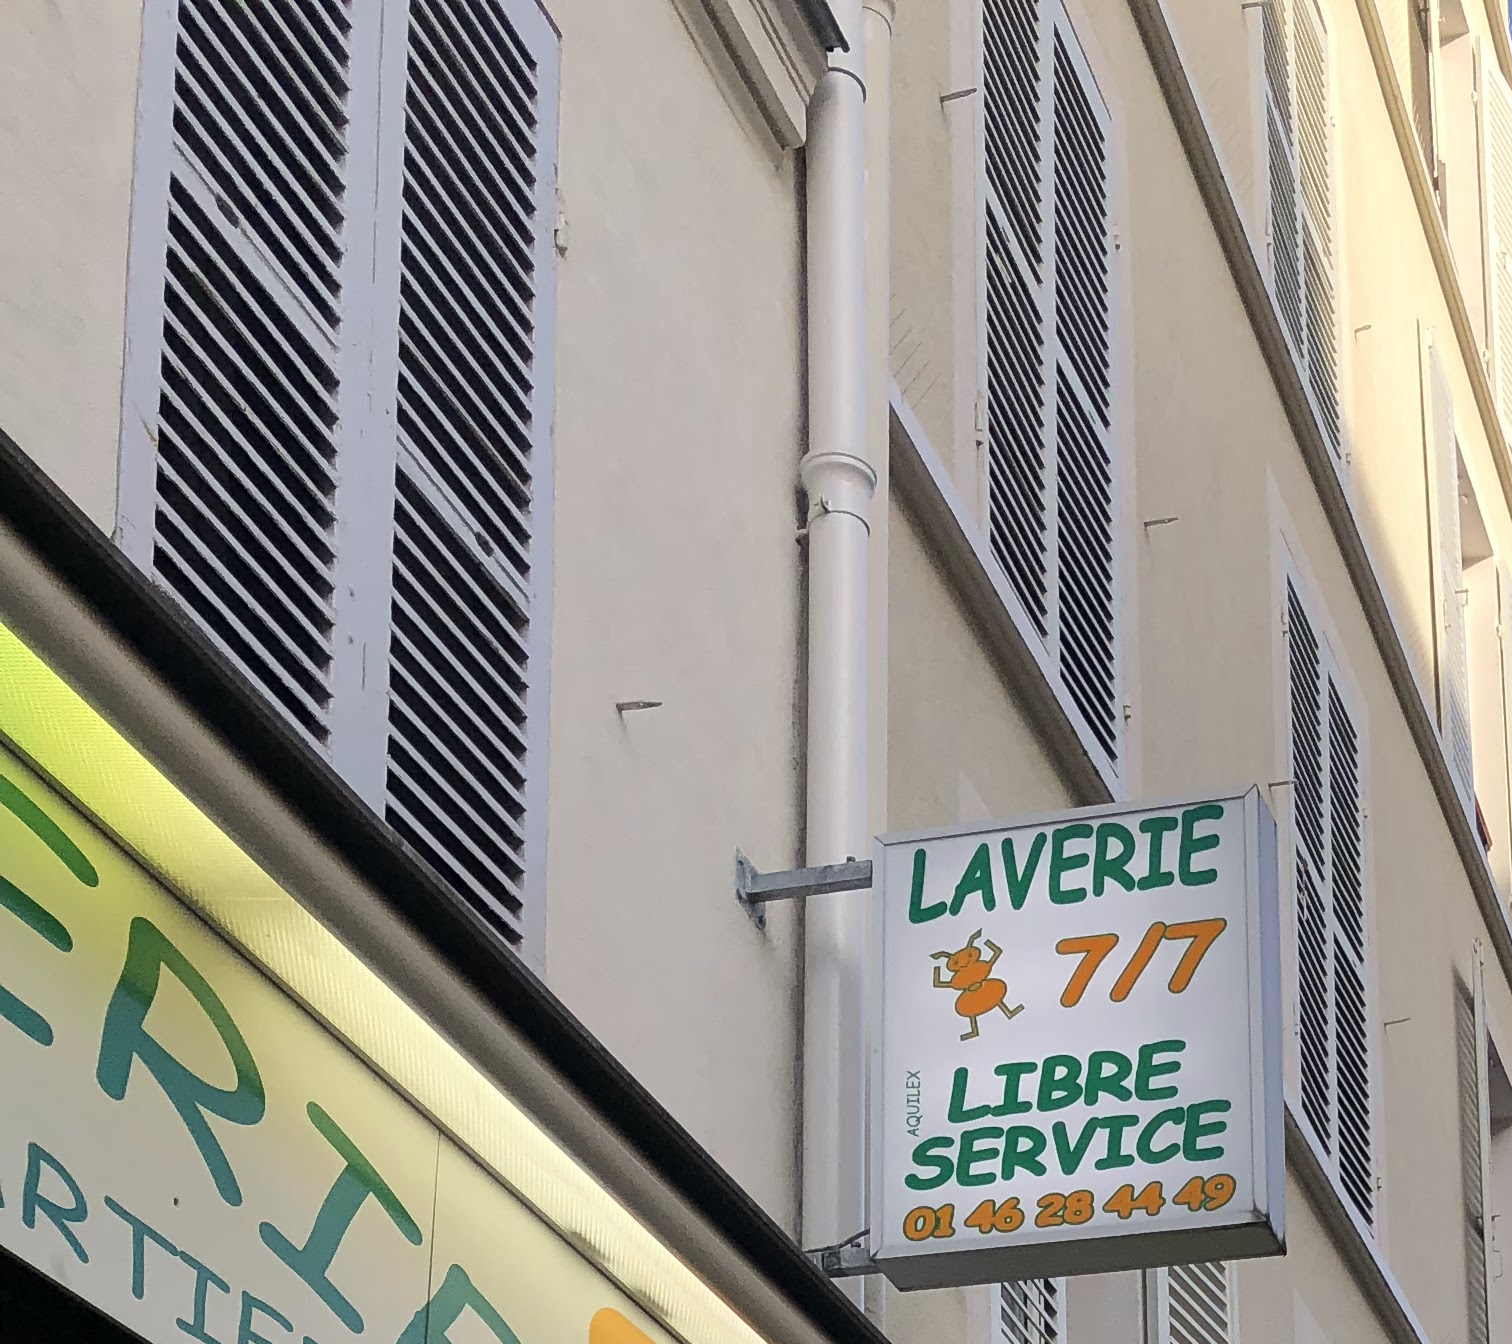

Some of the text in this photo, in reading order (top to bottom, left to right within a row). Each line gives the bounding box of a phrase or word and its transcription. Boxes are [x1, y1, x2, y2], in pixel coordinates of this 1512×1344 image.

[908, 804, 1224, 924] LAVERIE
[1055, 917, 1228, 1008] 7/7
[906, 1070, 922, 1138] AQUILEX
[947, 1039, 1187, 1124] LIBRE
[904, 1099, 1232, 1191] SERVICE
[903, 1173, 1238, 1242] 01 46 28 44 49
